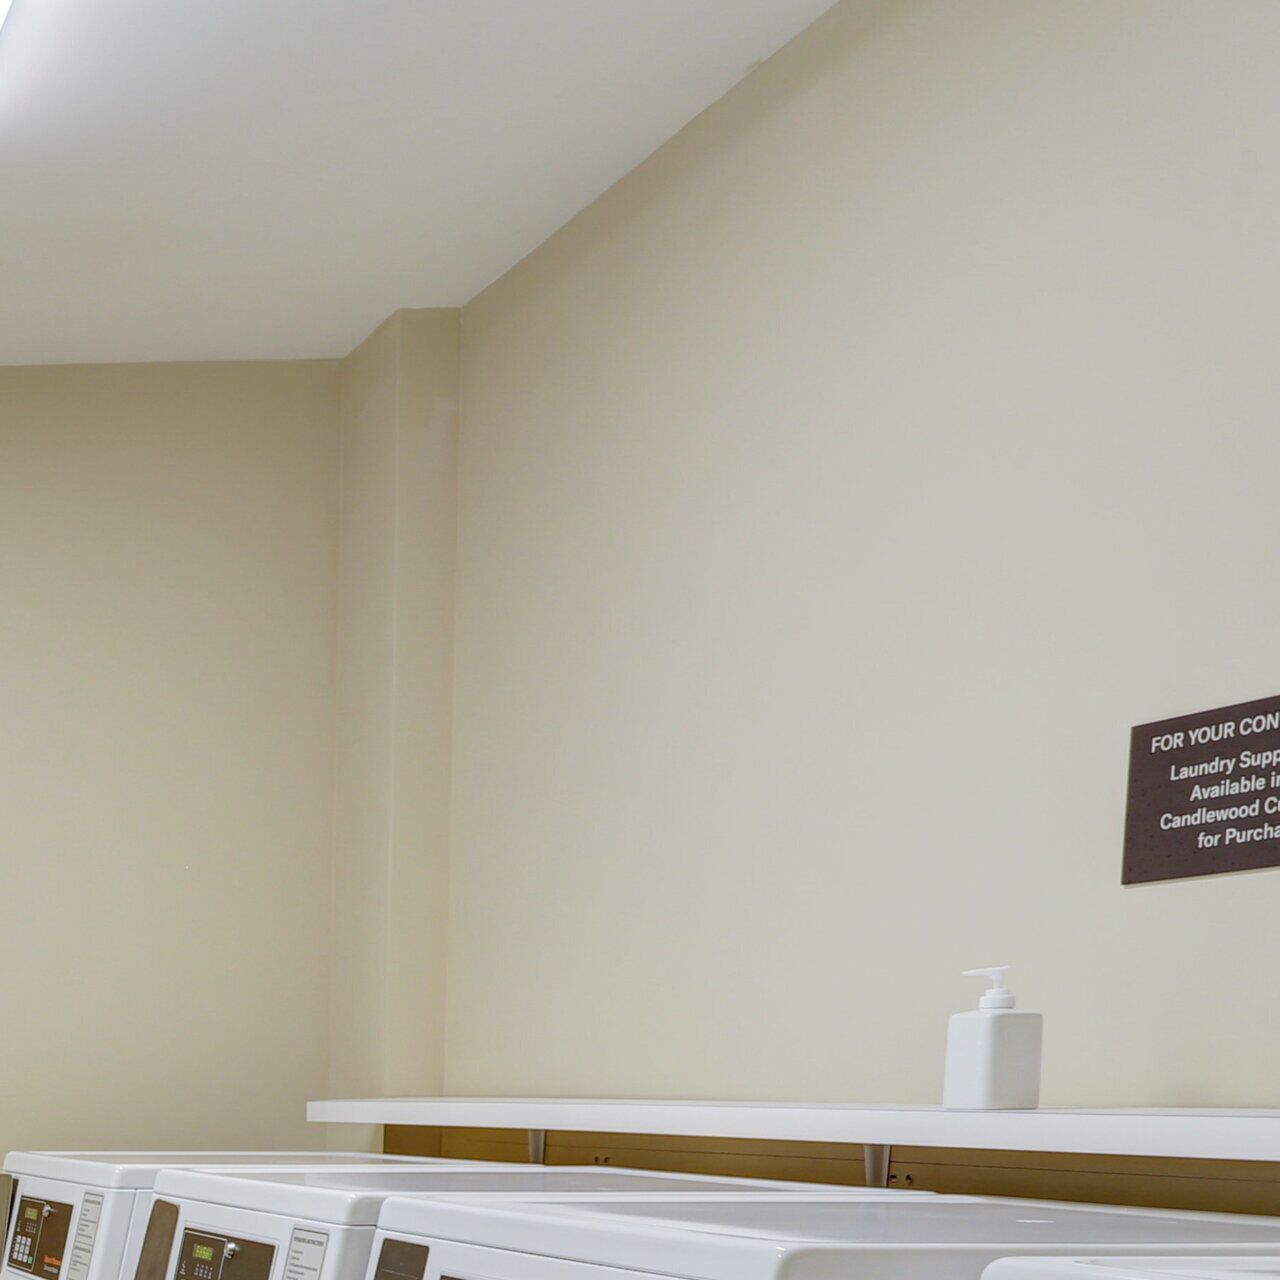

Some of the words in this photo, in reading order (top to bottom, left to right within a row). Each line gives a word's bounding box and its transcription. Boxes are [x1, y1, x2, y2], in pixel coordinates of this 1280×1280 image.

[1151, 732, 1185, 753] FOR
[1188, 722, 1236, 745] YOUR
[1170, 756, 1236, 781] Laundry
[1190, 774, 1265, 801] Available
[1160, 799, 1259, 830] Candlewood
[1198, 832, 1221, 848] for
